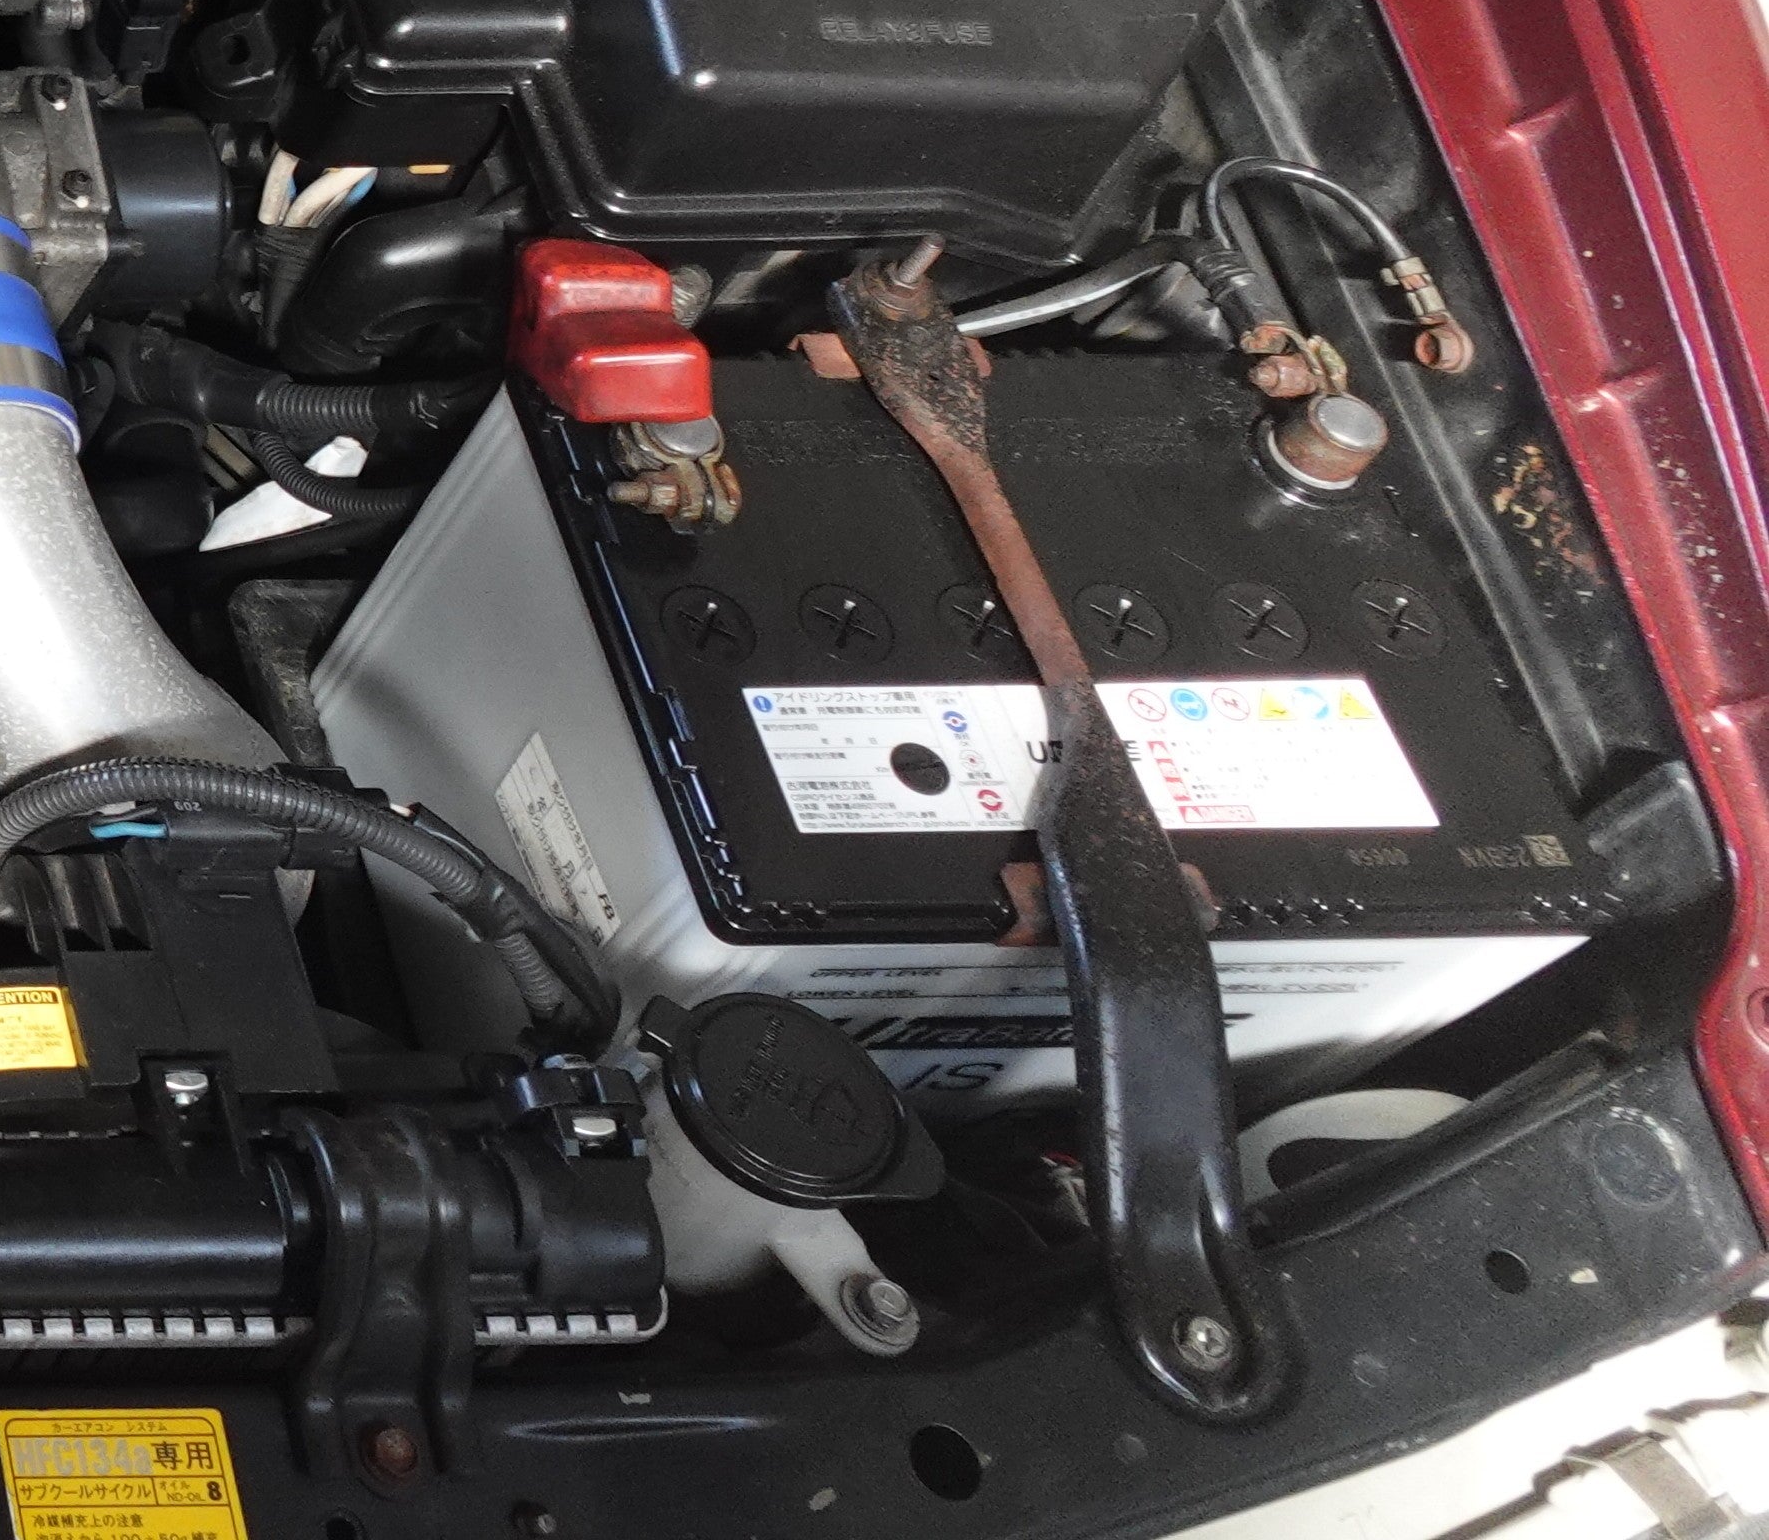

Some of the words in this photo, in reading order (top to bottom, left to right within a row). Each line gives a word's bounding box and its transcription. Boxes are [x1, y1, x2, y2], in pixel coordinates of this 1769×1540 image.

[52, 1422, 114, 1433] カーエアコン
[127, 1421, 169, 1432] システム
[12, 1437, 153, 1477] HFC134a
[152, 1441, 215, 1472] 専用
[19, 1483, 152, 1501] サブクールサイクル
[205, 1480, 223, 1502] 8
[33, 1514, 144, 1528] 冷媒補充上の注意
